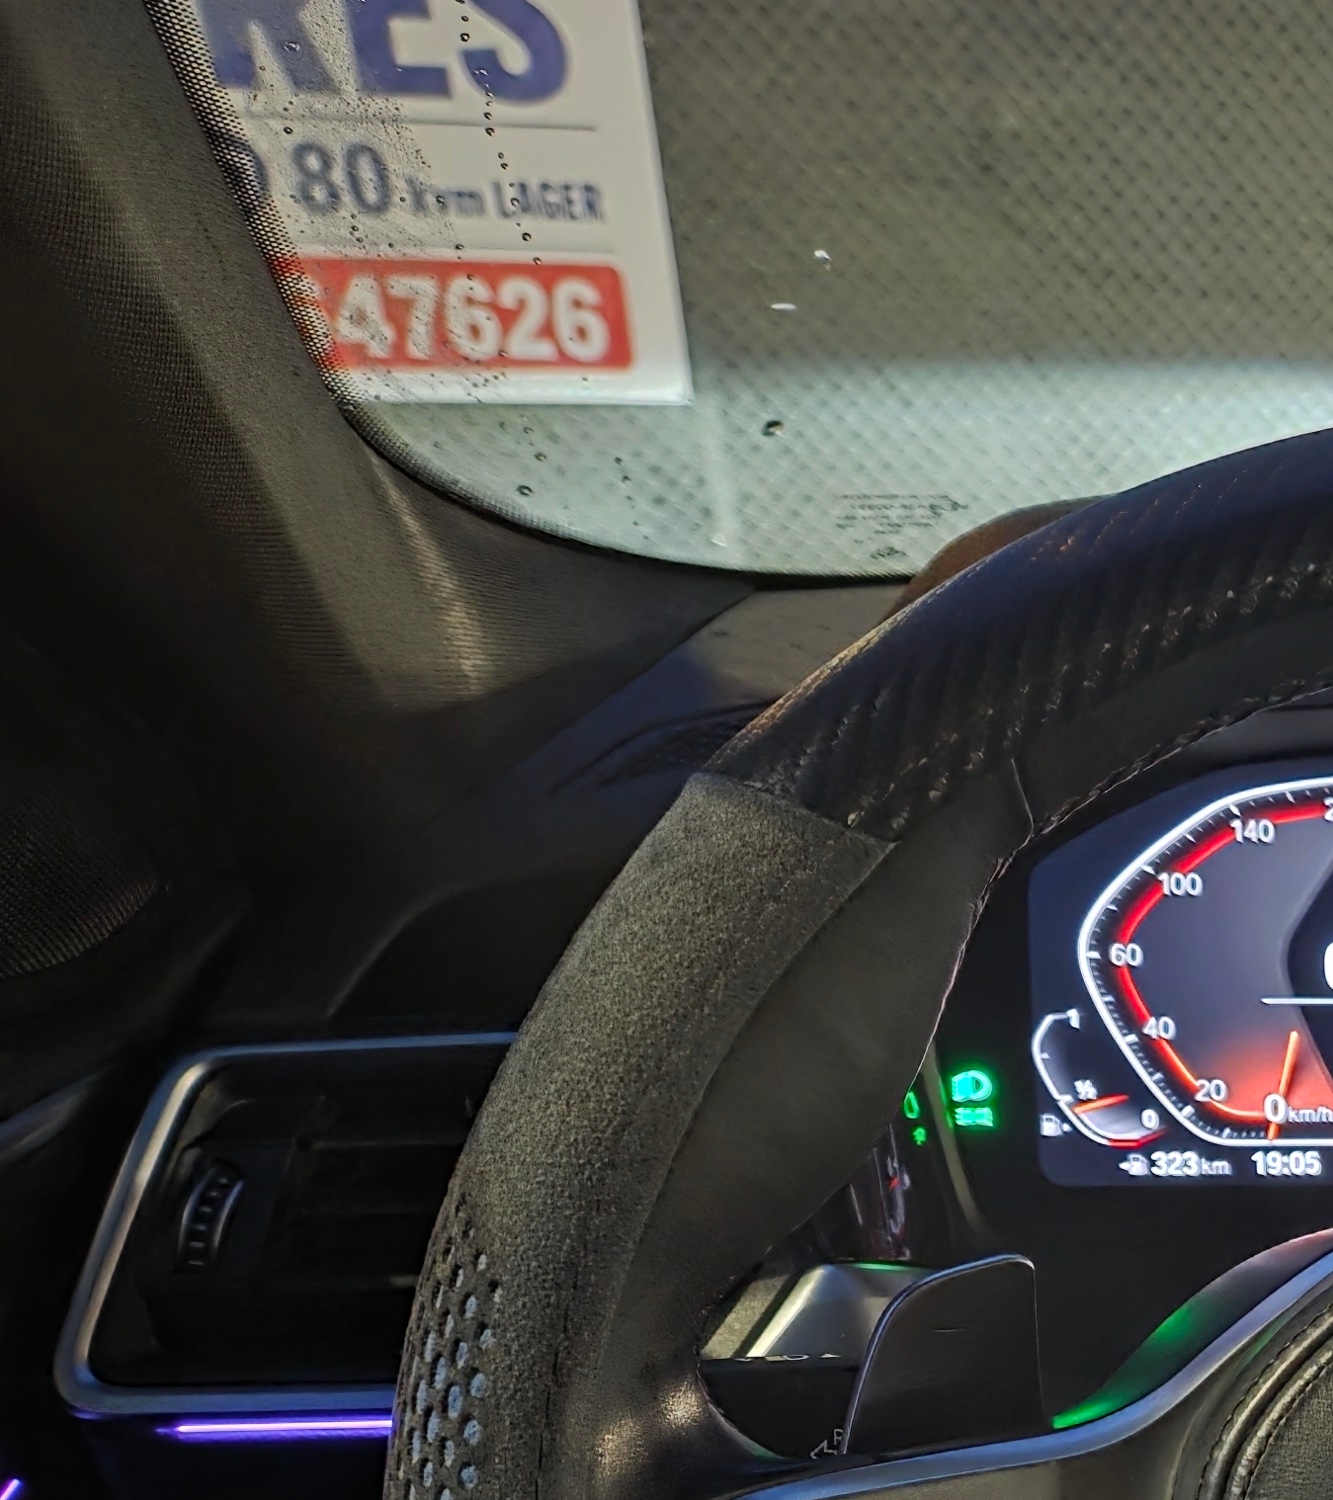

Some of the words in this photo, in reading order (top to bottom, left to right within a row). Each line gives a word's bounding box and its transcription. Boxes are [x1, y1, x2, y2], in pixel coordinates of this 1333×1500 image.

[291, 141, 393, 215] 80
[1233, 818, 1275, 844] 140
[1160, 872, 1202, 897] 100
[1109, 943, 1142, 968] 60
[1142, 1016, 1176, 1041] 40
[1195, 1079, 1228, 1102] 20
[1141, 1108, 1160, 1130] 0
[1263, 1093, 1287, 1122] 0
[1150, 1151, 1199, 1176] 323
[1201, 1158, 1232, 1176] km
[1251, 1151, 1322, 1176] 19:05
